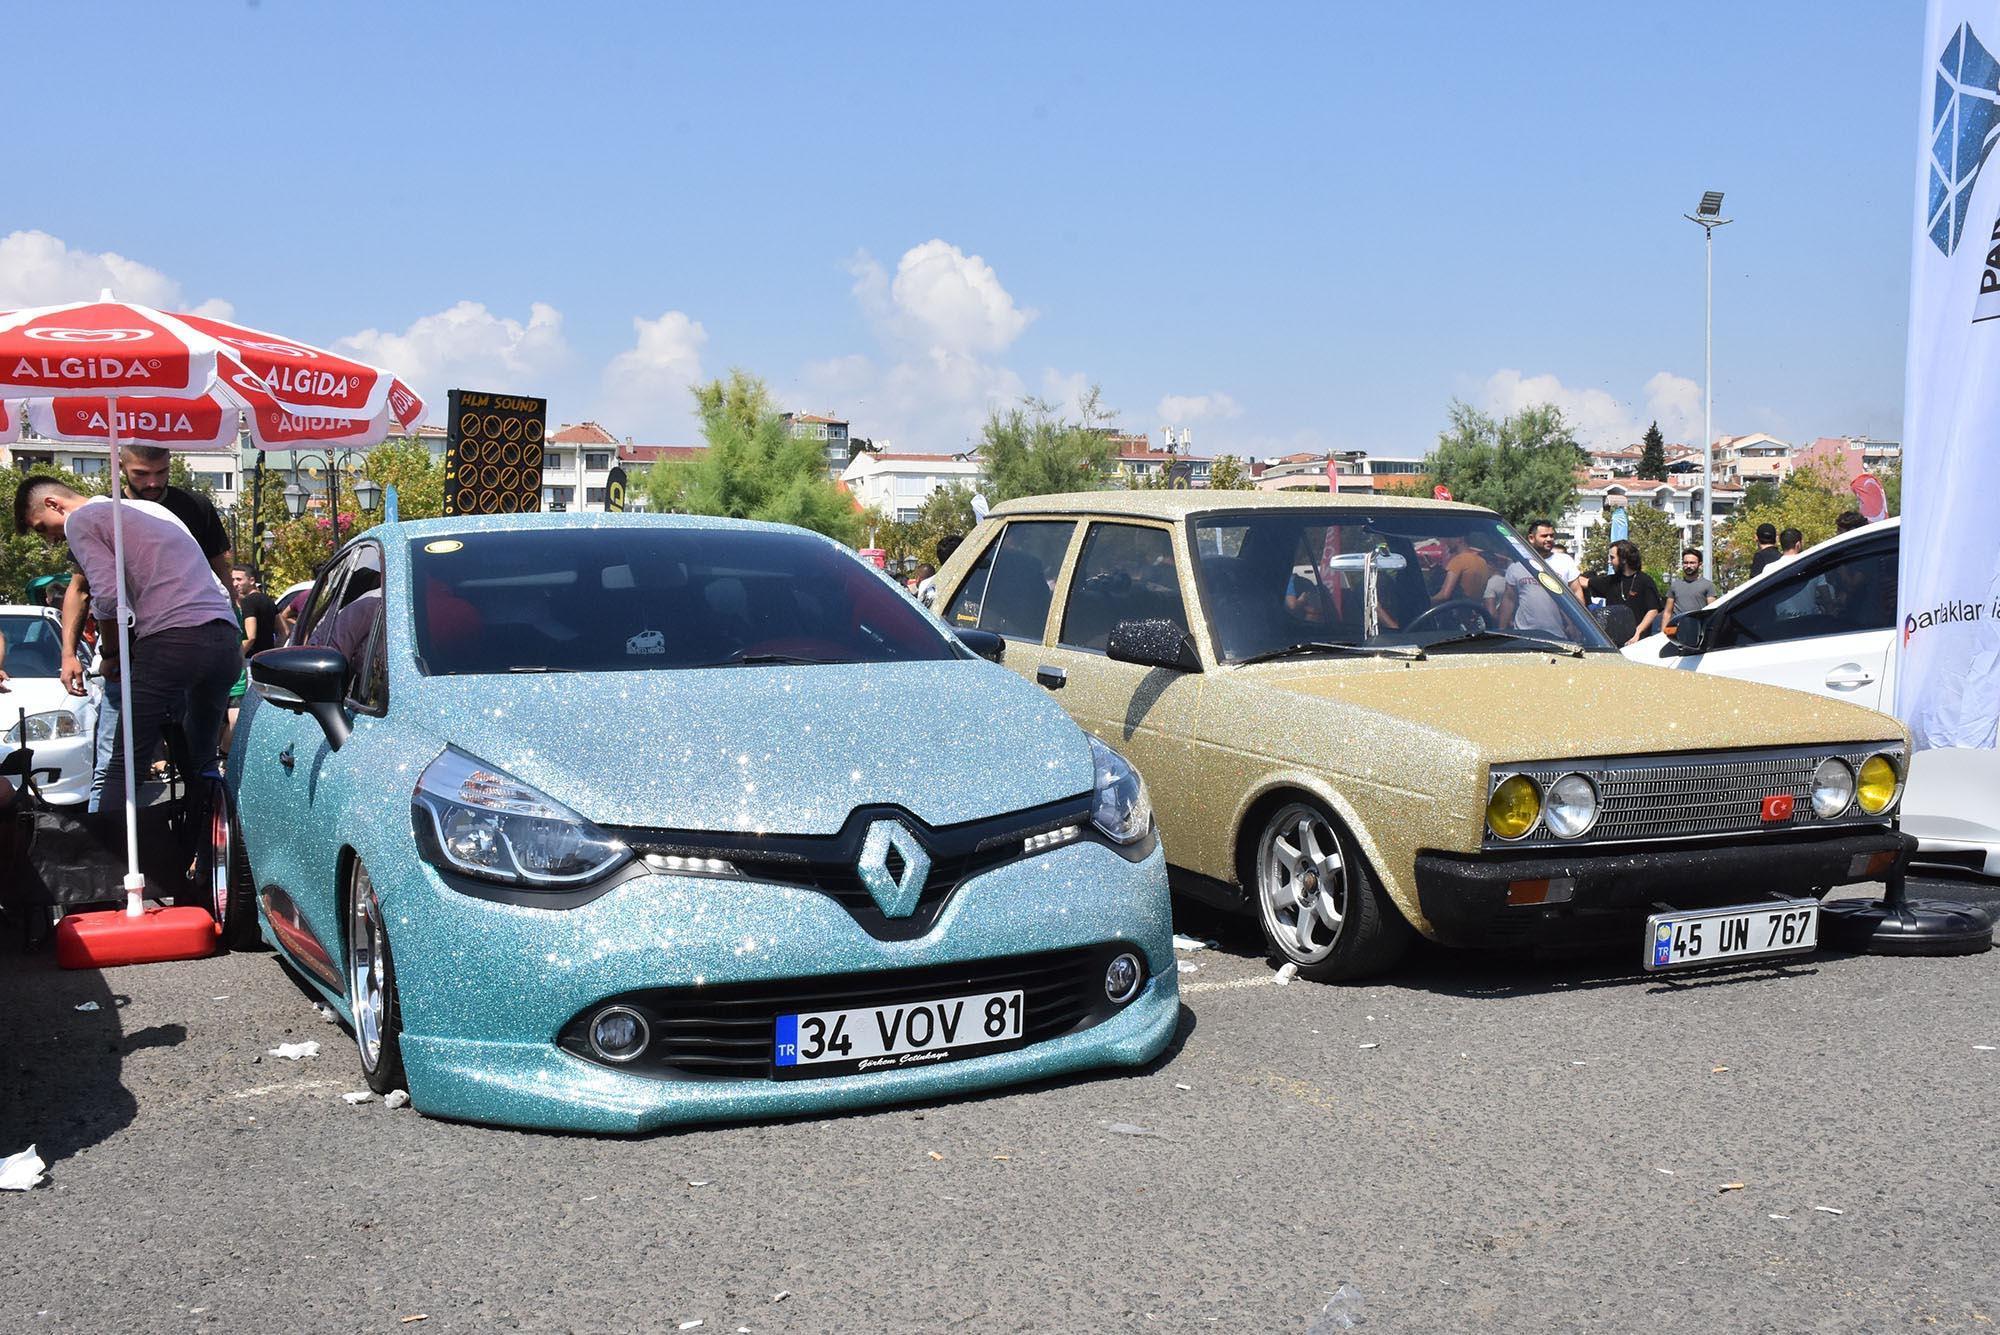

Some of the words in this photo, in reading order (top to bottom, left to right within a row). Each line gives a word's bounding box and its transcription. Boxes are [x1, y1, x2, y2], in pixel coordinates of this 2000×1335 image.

[461, 394, 489, 408] HLM
[494, 398, 538, 413] SOUND
[1673, 923, 1702, 957] 45
[1719, 917, 1749, 952] UN
[1767, 910, 1812, 947] 767
[1658, 946, 1670, 956] TR
[801, 1014, 852, 1060] 34
[875, 1001, 965, 1051] VOV
[984, 994, 1021, 1038] 81
[778, 1043, 795, 1056] TR
